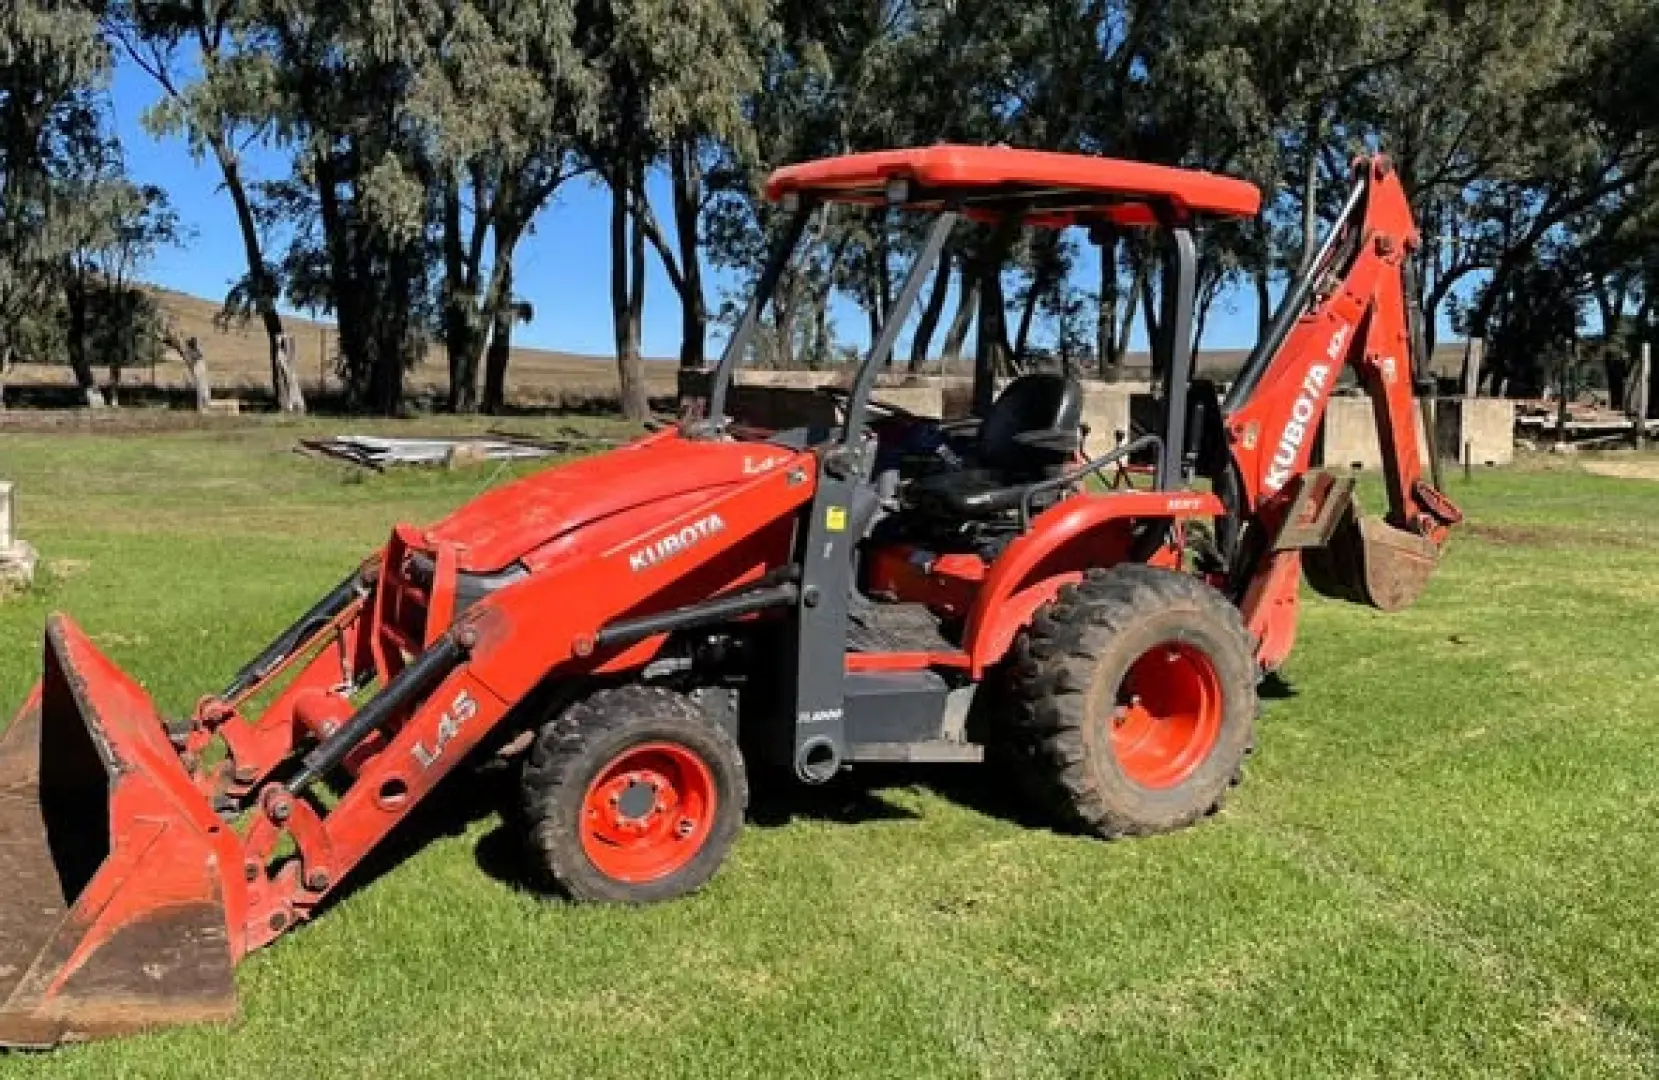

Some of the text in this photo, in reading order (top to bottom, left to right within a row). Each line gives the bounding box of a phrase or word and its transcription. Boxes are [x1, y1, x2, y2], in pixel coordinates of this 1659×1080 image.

[1264, 364, 1330, 490] KUBOTA
[629, 513, 726, 573] KUBOTA
[410, 688, 478, 769] L45
